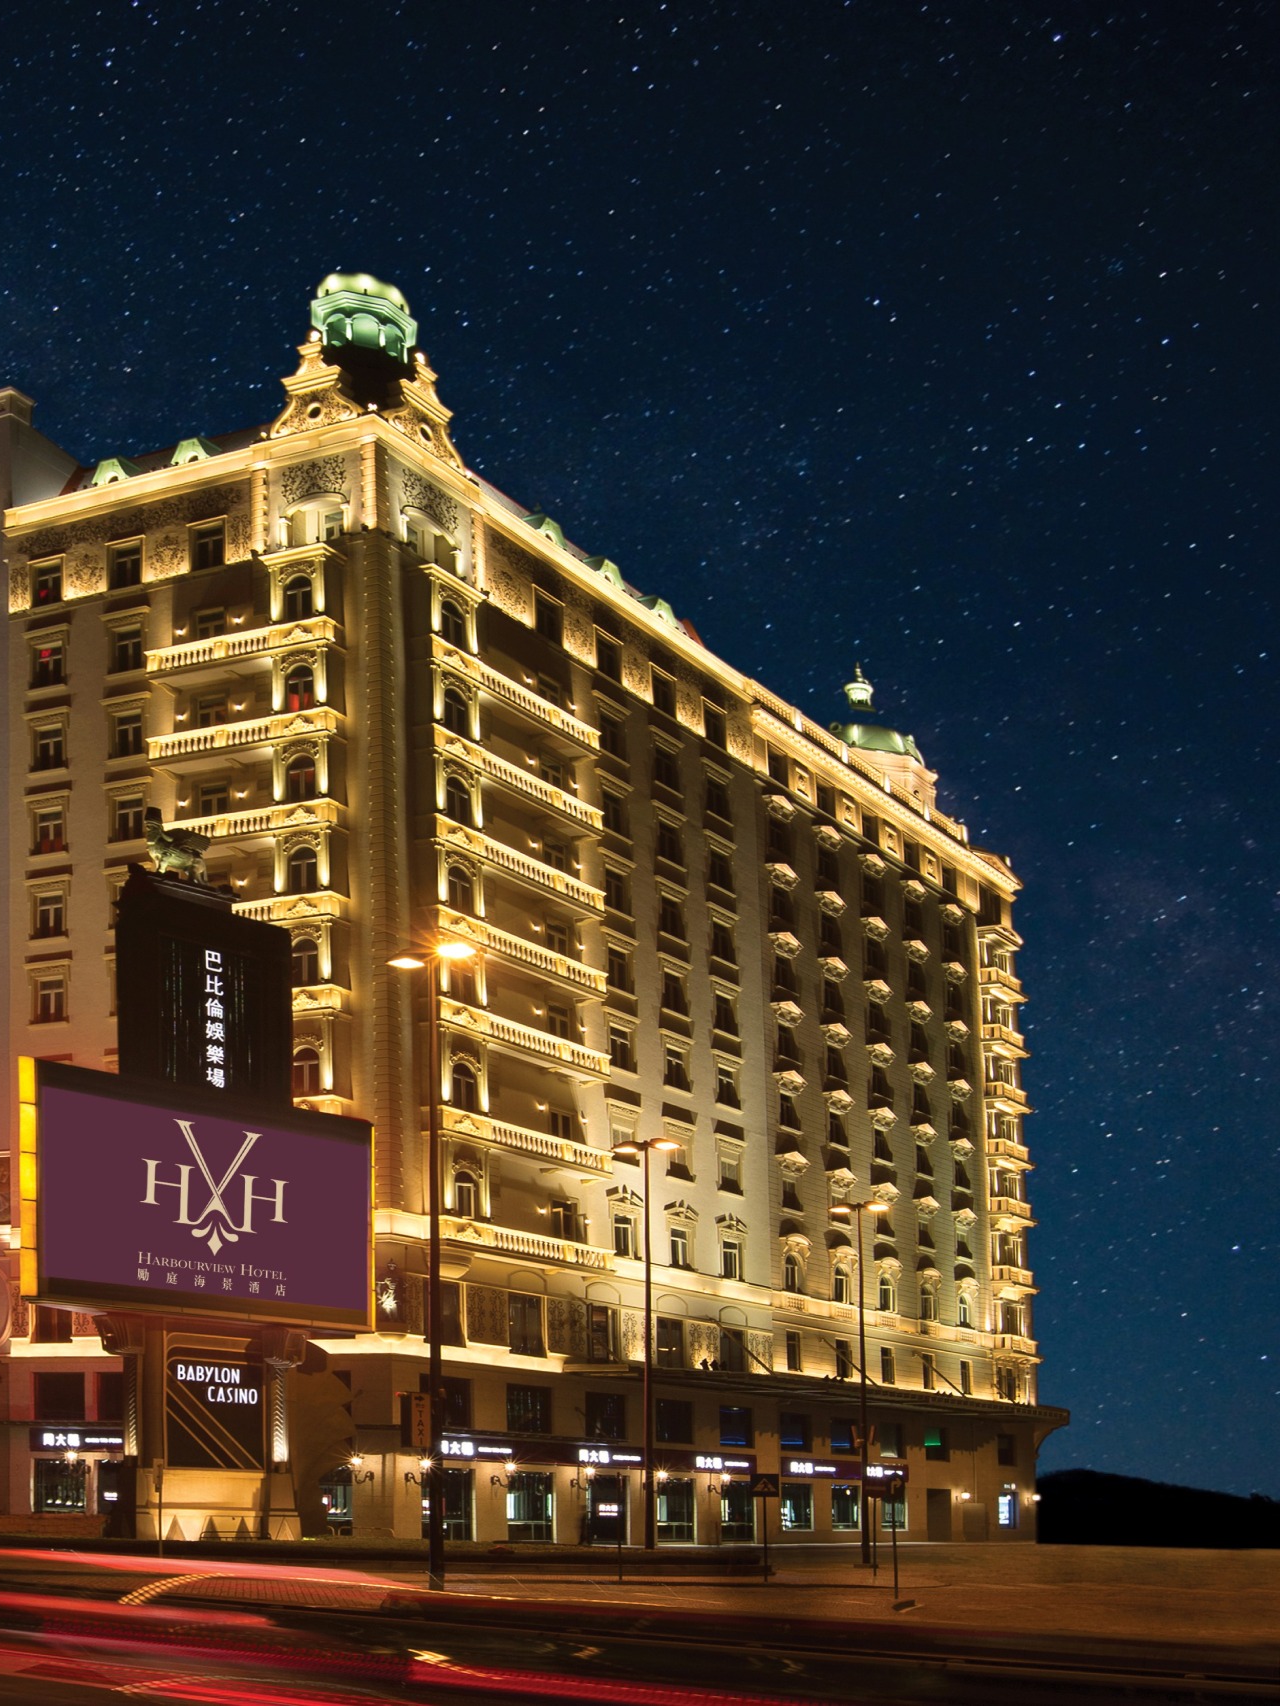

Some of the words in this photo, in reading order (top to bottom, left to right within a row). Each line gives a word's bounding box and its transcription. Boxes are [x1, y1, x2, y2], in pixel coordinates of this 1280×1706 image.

[204, 949, 226, 1089] 巴比倫娛樂場
[137, 1251, 236, 1275] HARBOURVIEW
[240, 1263, 287, 1281] HOTEL
[137, 1267, 287, 1297] 勵庭海景酒店
[177, 1364, 240, 1384] BABYLON
[207, 1386, 258, 1404] CASINO
[416, 1410, 425, 1445] TAXI
